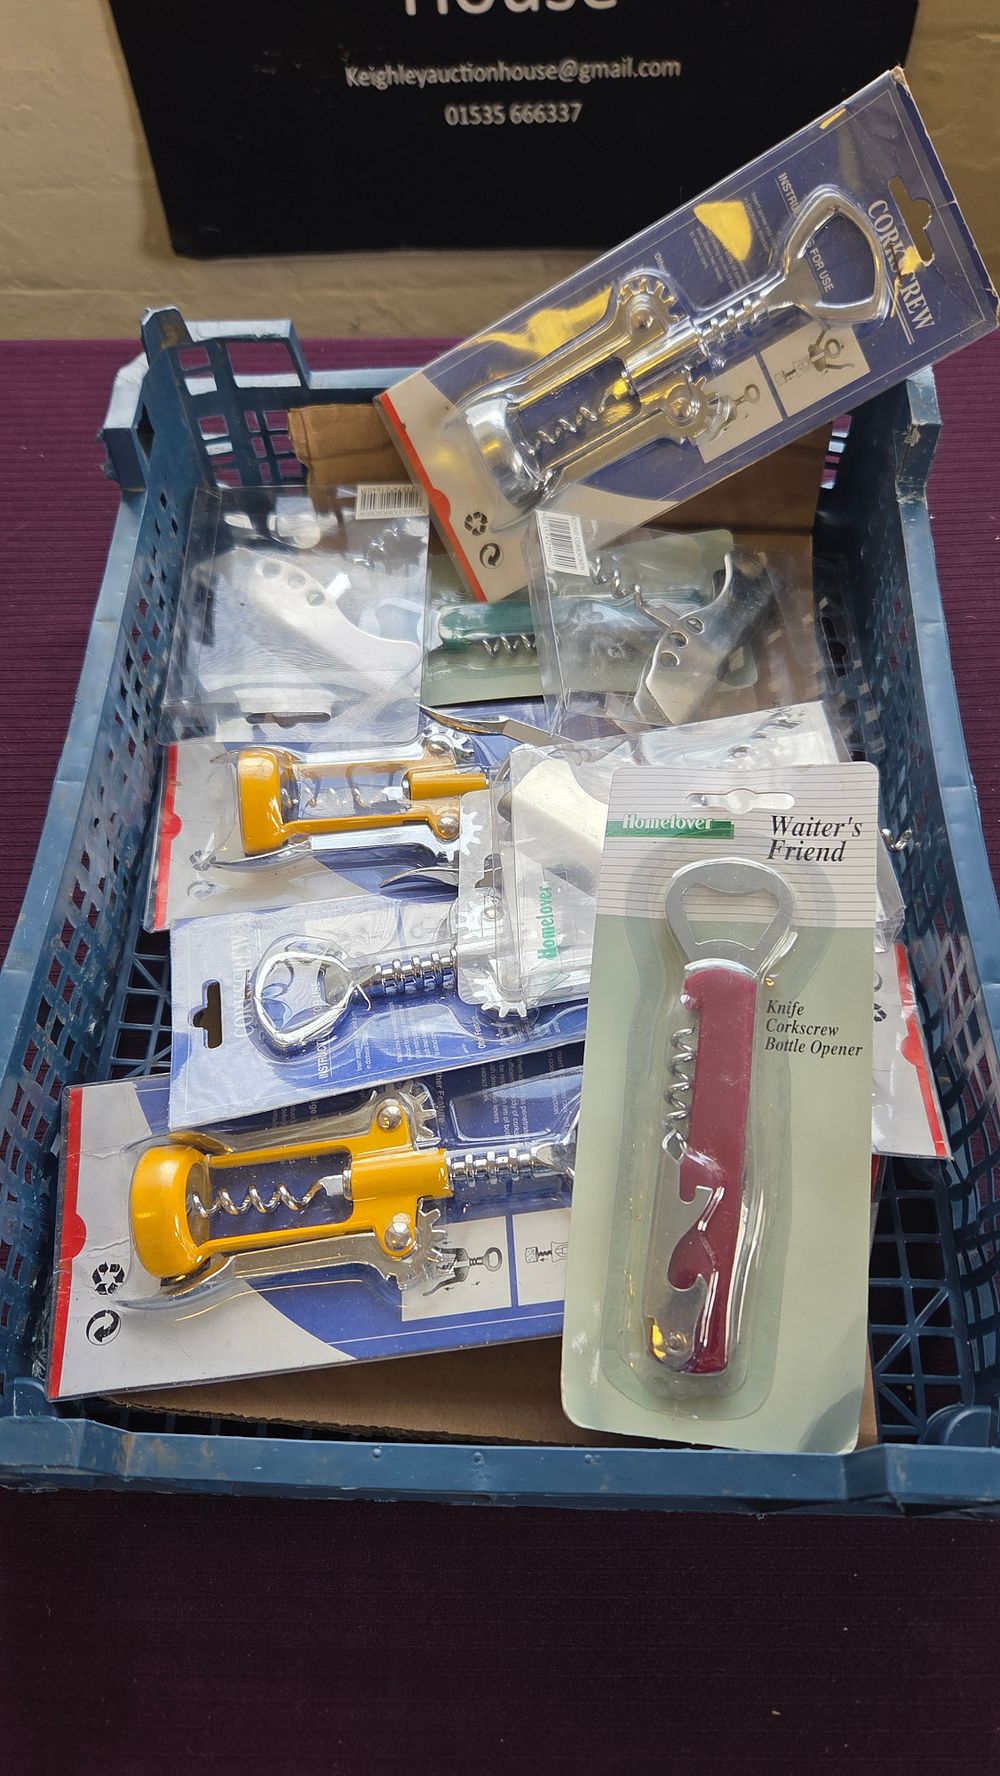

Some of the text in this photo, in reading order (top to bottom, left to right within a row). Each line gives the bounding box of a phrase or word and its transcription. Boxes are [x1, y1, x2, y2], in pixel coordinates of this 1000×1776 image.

[346, 57, 682, 90] Keighleyauctionhouse@gmail.com
[444, 101, 583, 126] 01535 666337
[809, 248, 825, 271] FOR
[818, 269, 835, 293] USE
[622, 814, 713, 830] Homelover
[769, 814, 862, 838] Waiter's
[766, 839, 846, 862] Friend
[536, 886, 558, 960] Homelover
[766, 999, 804, 1018] Knife
[765, 1018, 839, 1037] Corkscrew
[764, 1036, 863, 1059] Bottle Opener
